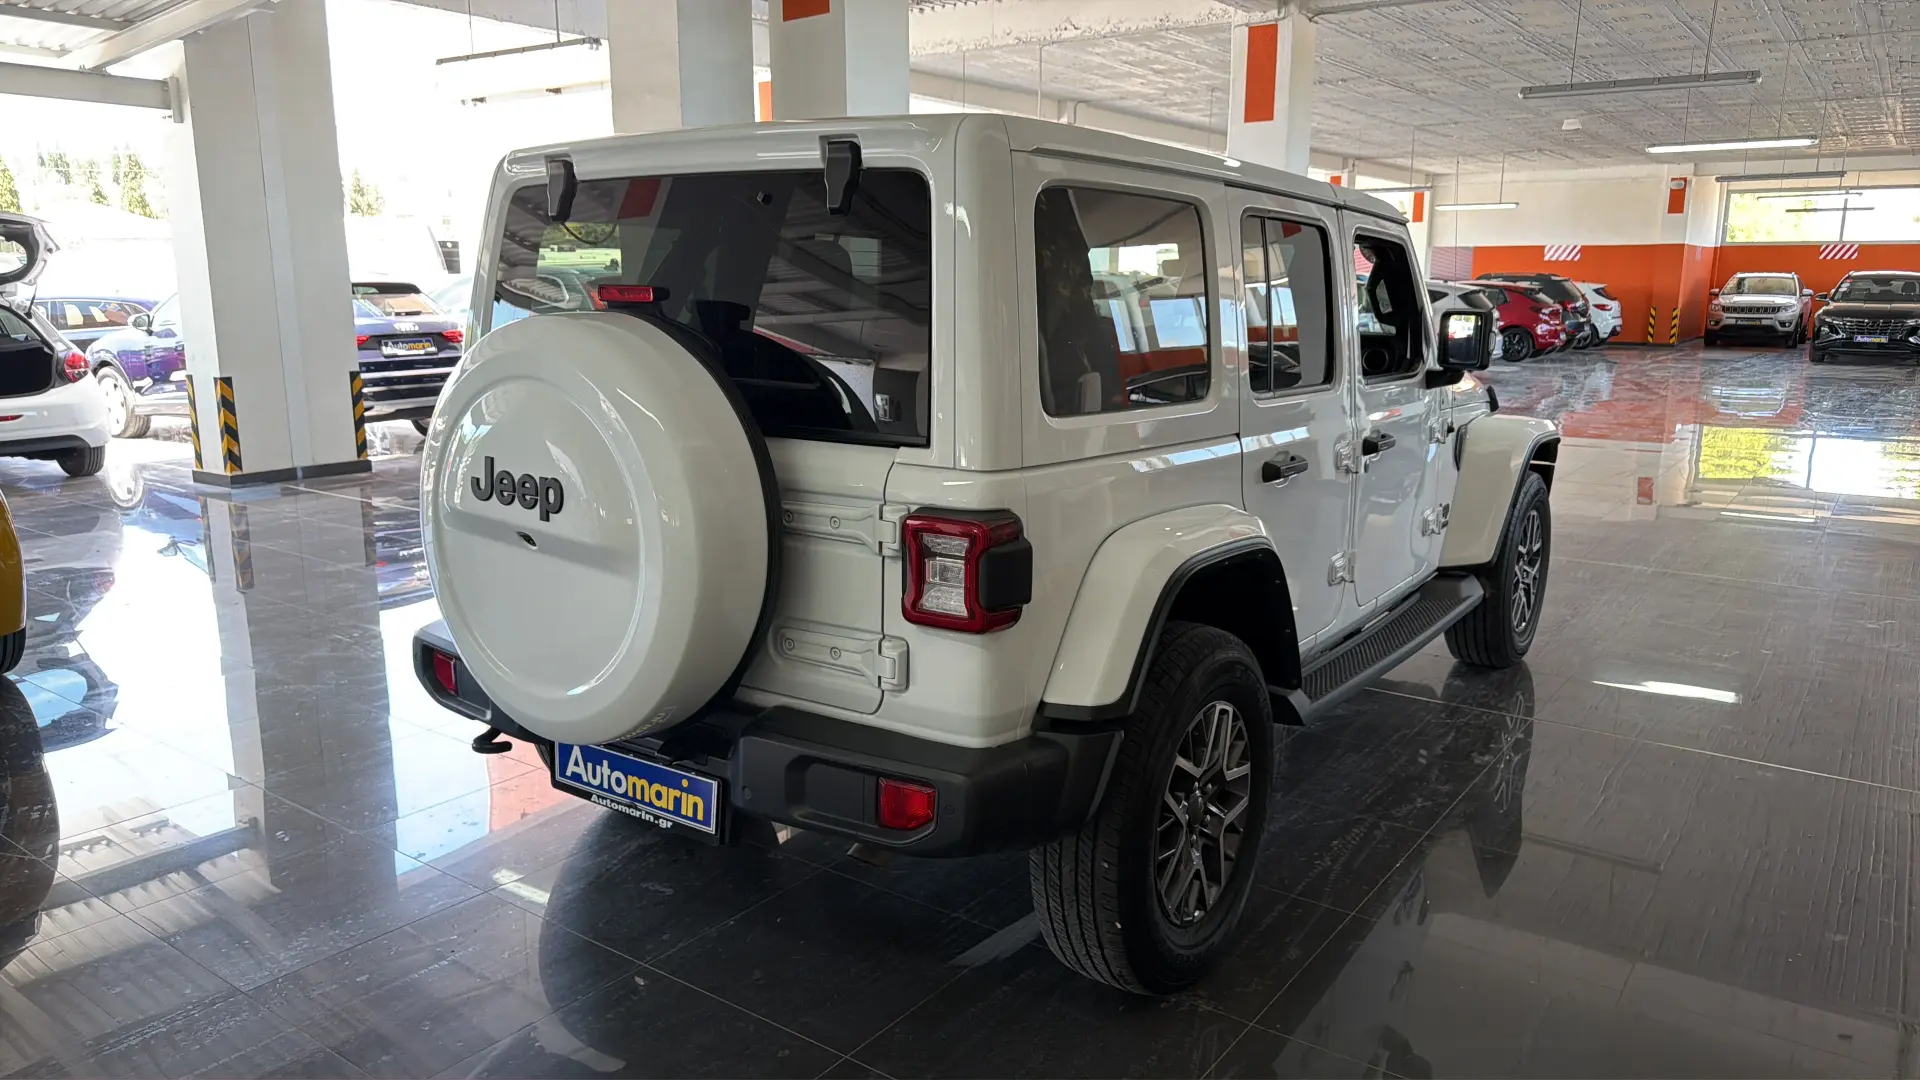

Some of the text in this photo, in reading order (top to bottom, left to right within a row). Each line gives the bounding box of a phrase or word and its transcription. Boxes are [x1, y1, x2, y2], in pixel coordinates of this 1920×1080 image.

[471, 456, 564, 522] Jeep
[565, 745, 704, 821] Automarin
[590, 794, 673, 829] Automarin.gr
